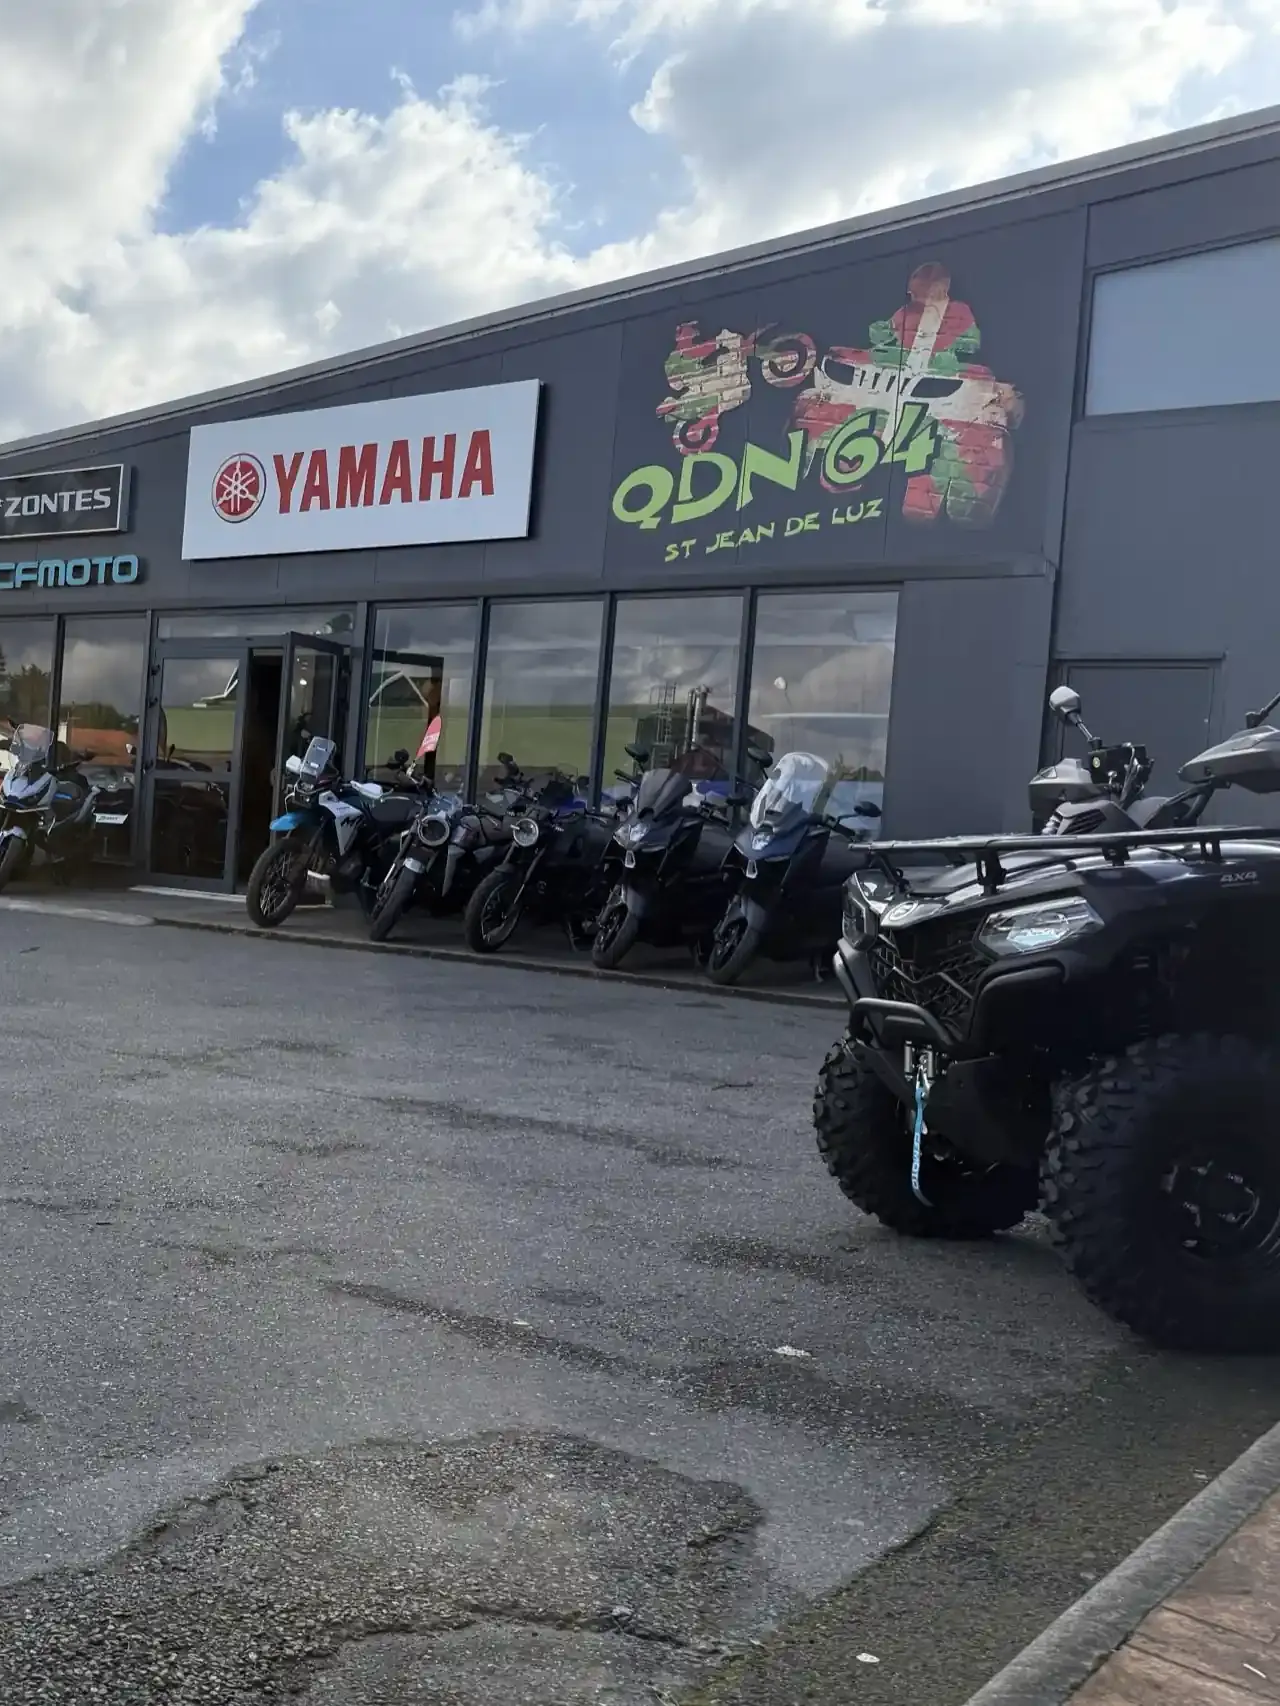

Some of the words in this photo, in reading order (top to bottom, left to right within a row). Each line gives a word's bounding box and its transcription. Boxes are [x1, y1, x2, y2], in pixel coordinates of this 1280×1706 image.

[4, 487, 111, 517] ZONTES
[272, 429, 495, 514] YAMAHA
[611, 429, 808, 530] QDN
[825, 402, 937, 485] 64
[664, 539, 697, 563] ST
[705, 521, 776, 555] JEAN
[784, 511, 821, 538] DE
[831, 497, 884, 525] LUZ
